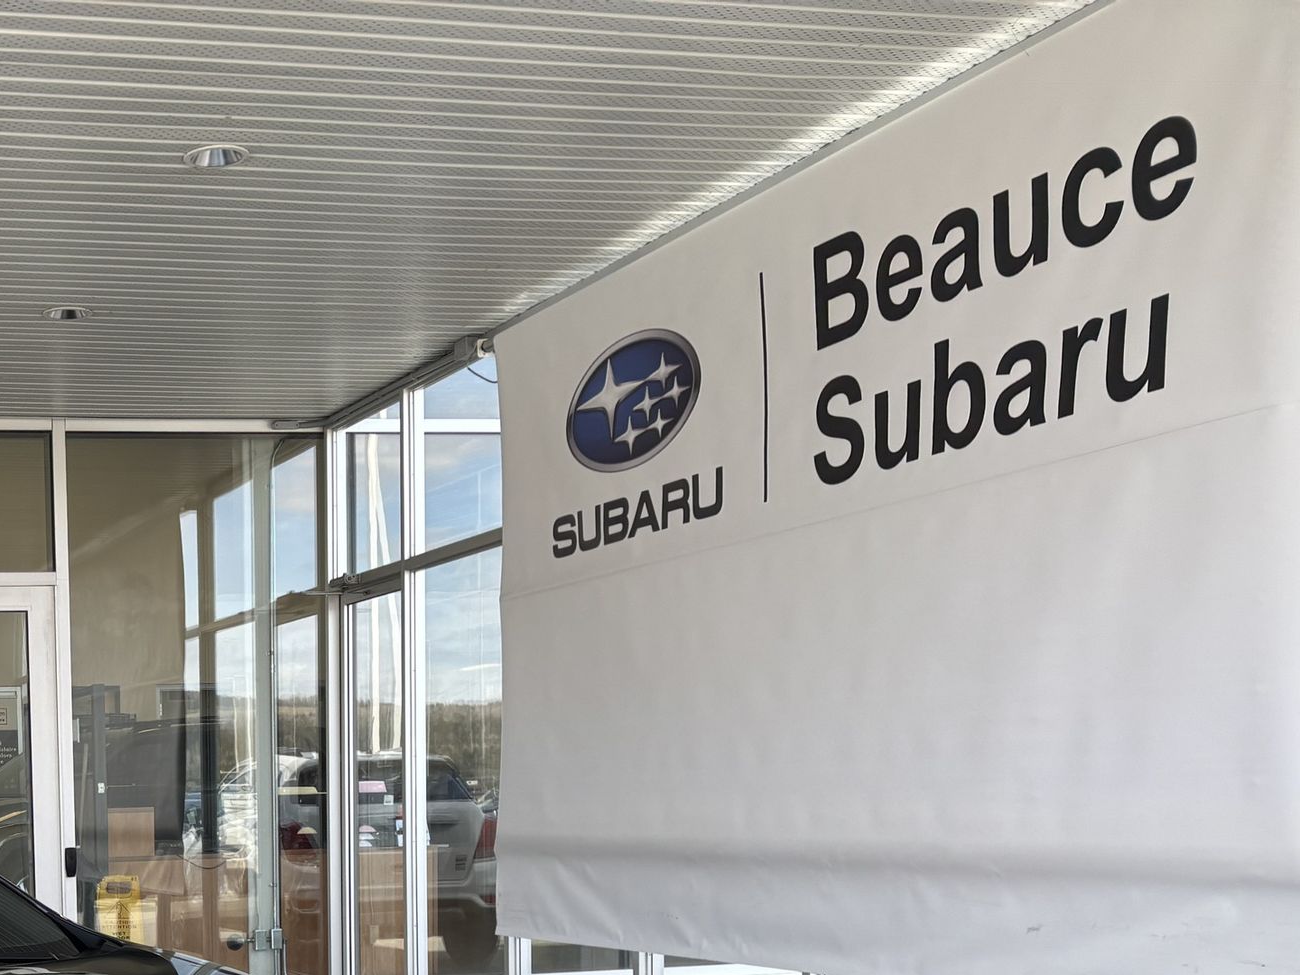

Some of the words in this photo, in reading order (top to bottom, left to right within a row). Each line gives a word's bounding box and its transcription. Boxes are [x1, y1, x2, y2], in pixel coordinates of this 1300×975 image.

[812, 115, 1198, 351] Beauce
[813, 293, 1170, 486] Subaru
[552, 467, 724, 559] SUBARU
